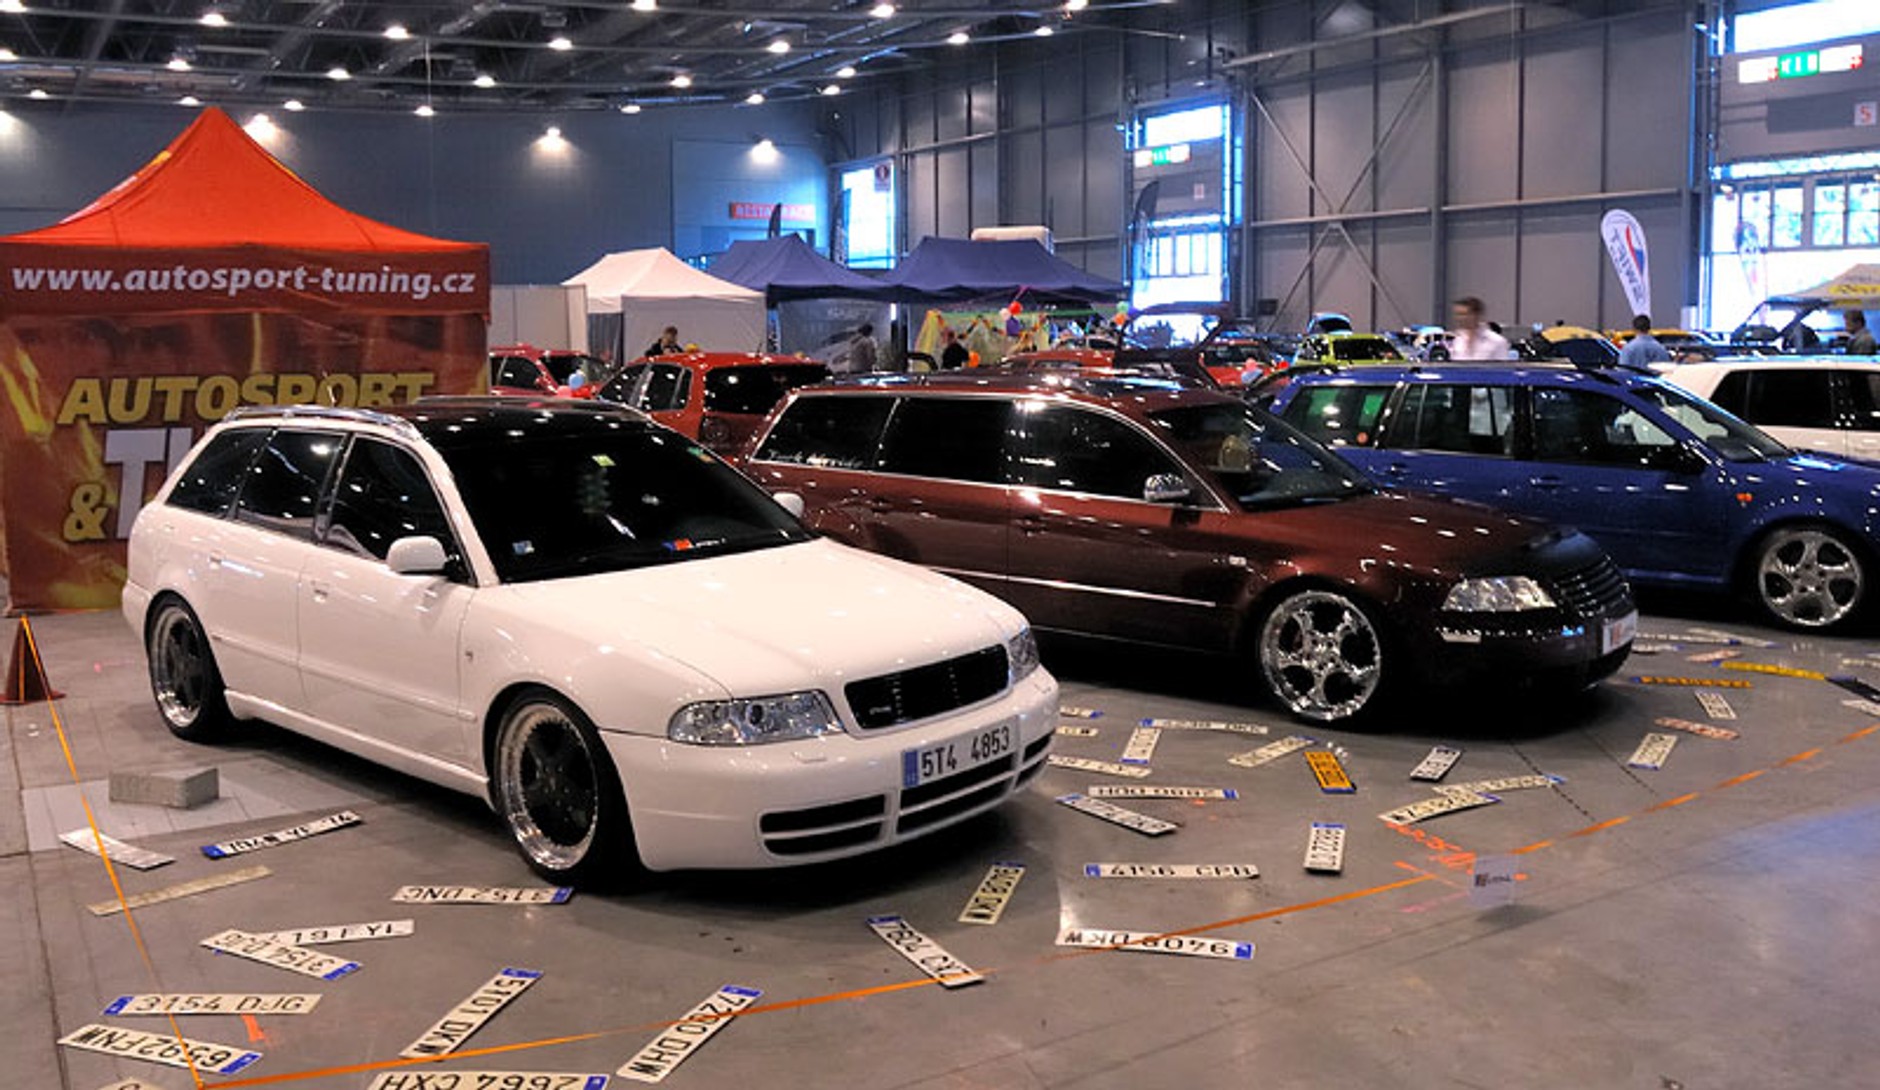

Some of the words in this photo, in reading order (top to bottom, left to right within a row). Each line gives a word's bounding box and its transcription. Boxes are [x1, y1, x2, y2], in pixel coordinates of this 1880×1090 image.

[12, 265, 476, 300] www.autosport-tuning.cz
[63, 484, 108, 541] &
[921, 744, 957, 778] 5T4
[971, 726, 1010, 762] 4853
[135, 996, 223, 1011] 3154
[235, 996, 305, 1011] DJG
[459, 978, 526, 1015] 5101
[476, 1074, 581, 1090] 2664
